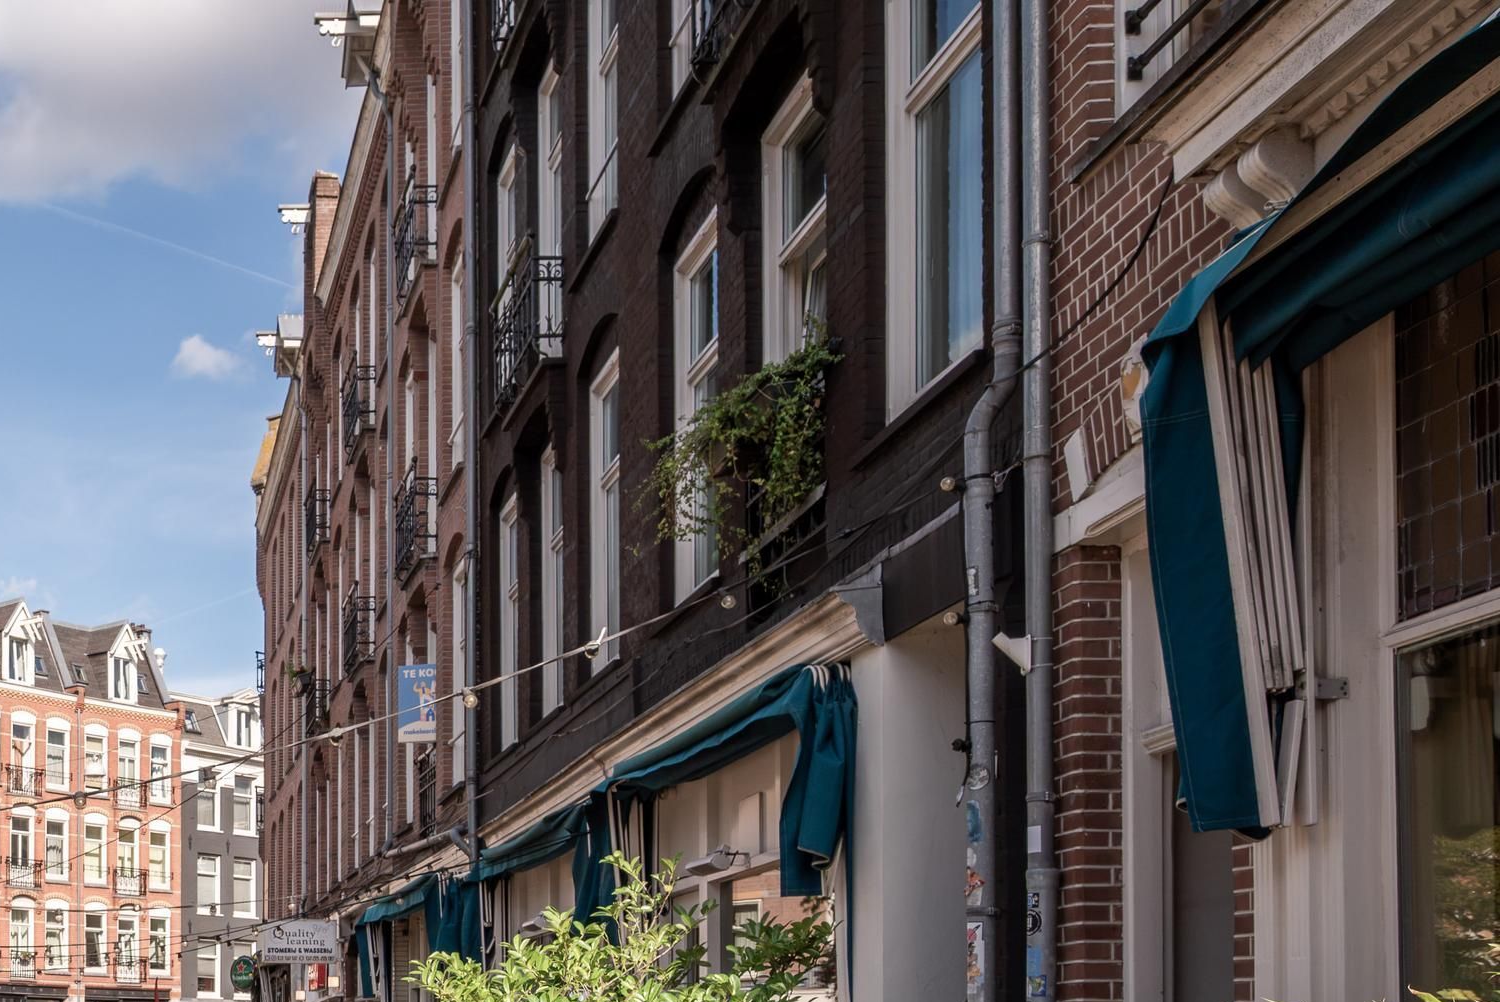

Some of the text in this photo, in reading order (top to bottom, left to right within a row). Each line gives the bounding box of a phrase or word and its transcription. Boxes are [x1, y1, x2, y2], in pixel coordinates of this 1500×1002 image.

[403, 668, 436, 678] TE KO
[273, 926, 315, 940] Quality
